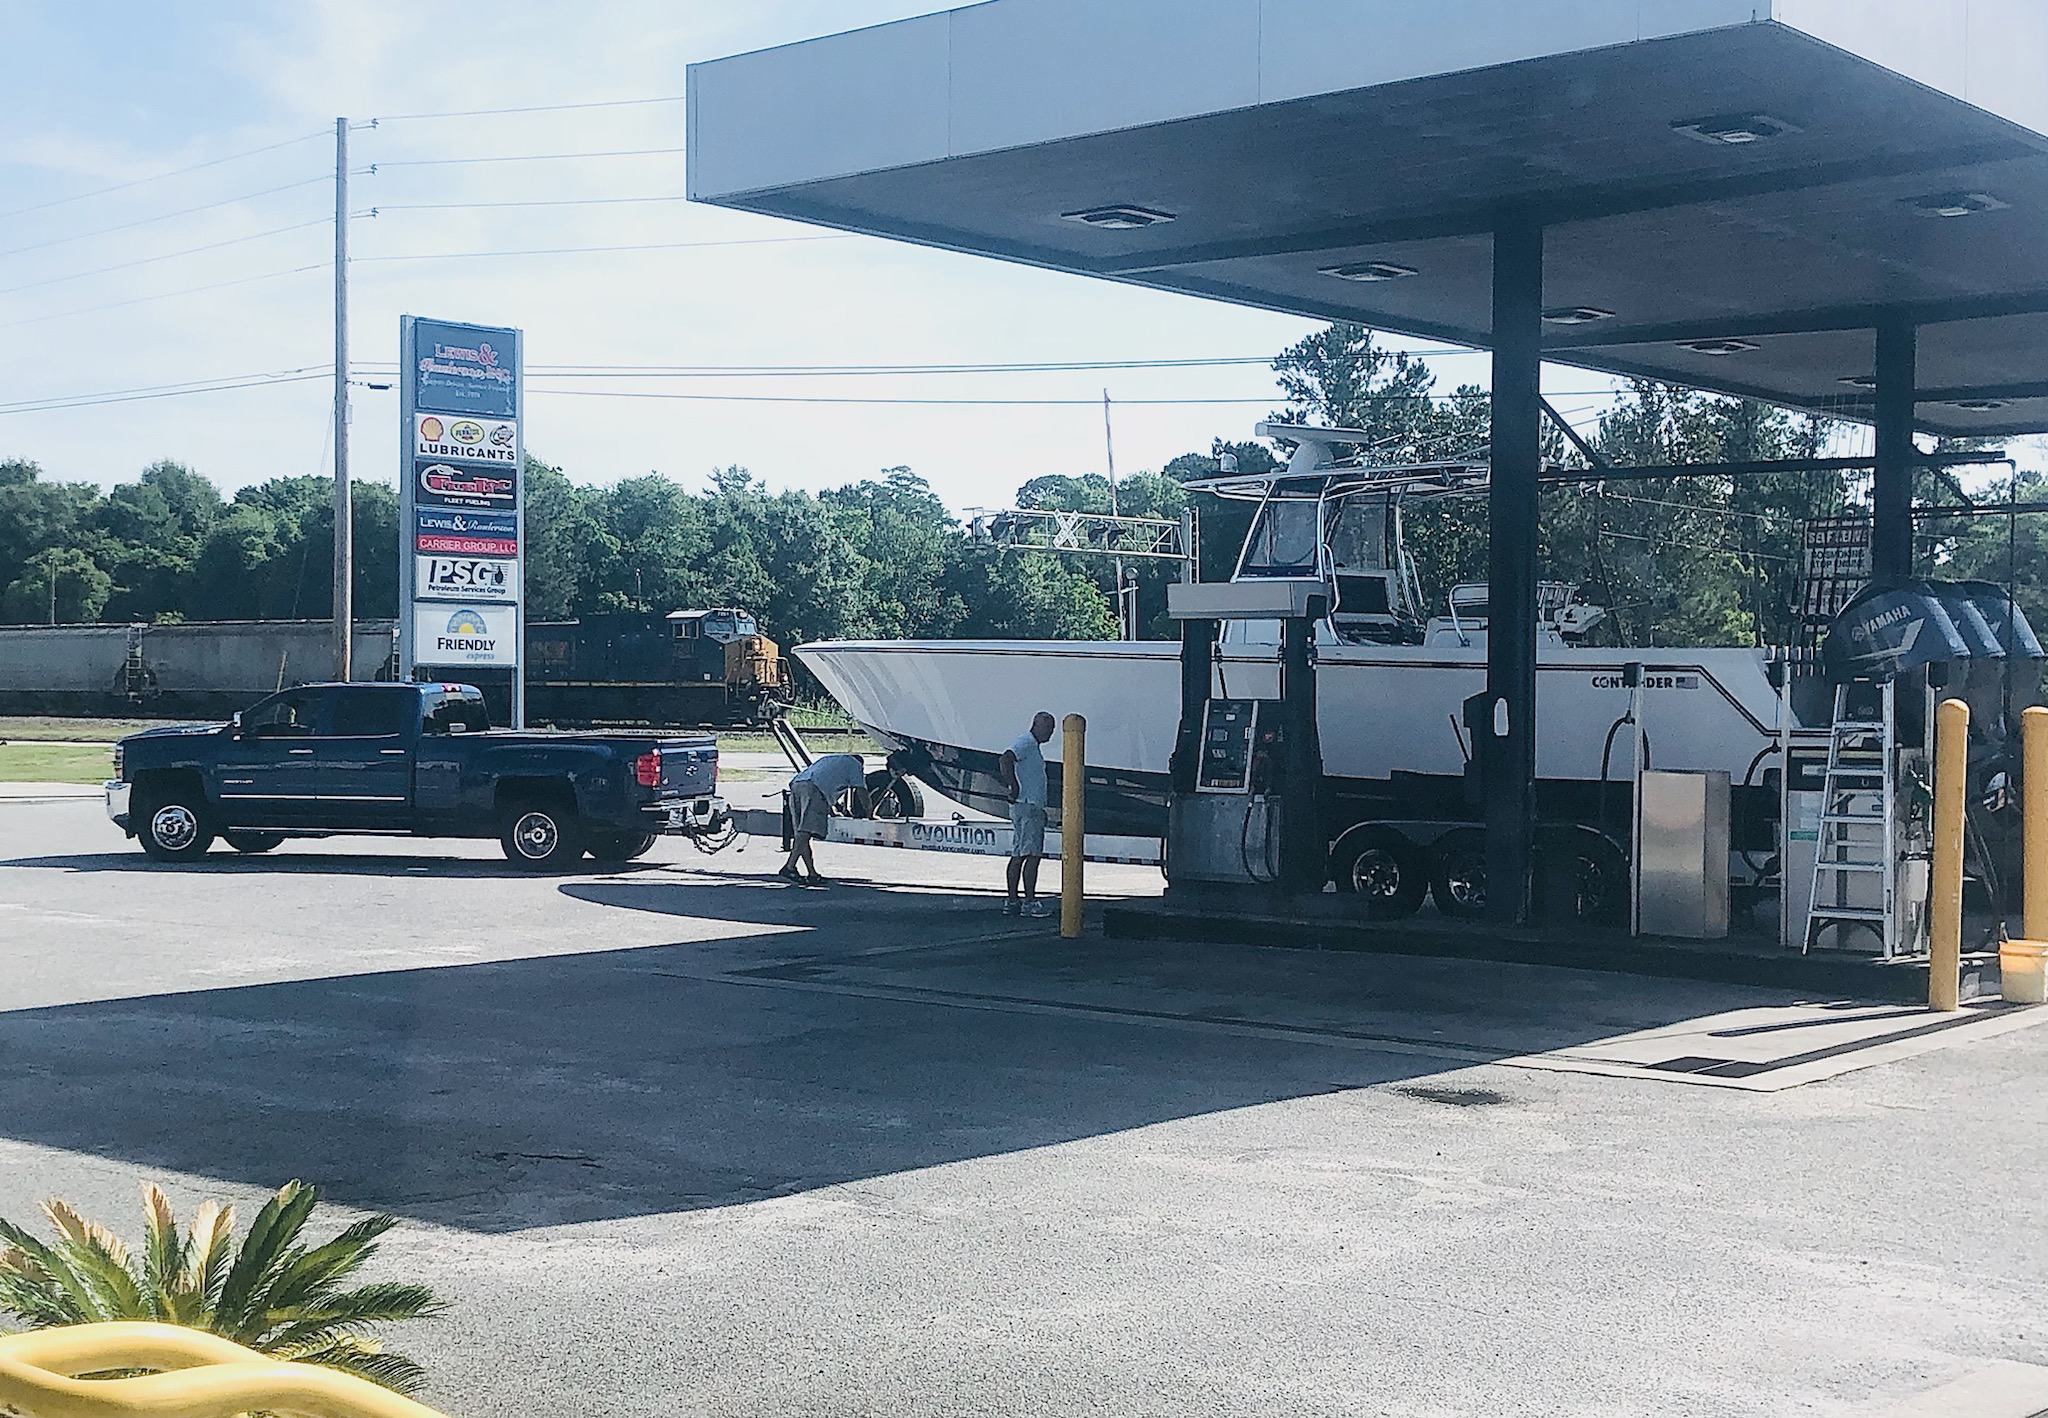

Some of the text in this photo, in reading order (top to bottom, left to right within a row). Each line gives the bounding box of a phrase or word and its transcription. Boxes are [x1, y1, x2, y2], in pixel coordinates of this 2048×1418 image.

[420, 443, 515, 461] LUBRICANTS
[419, 539, 461, 550] CARRIER
[499, 543, 517, 553] LLC
[430, 560, 492, 586] PSG
[428, 584, 460, 592] Petroleum
[487, 587, 506, 595] Group
[1861, 605, 1911, 635] YAMAHA
[437, 637, 496, 651] FRIENDLY
[466, 653, 495, 662] express
